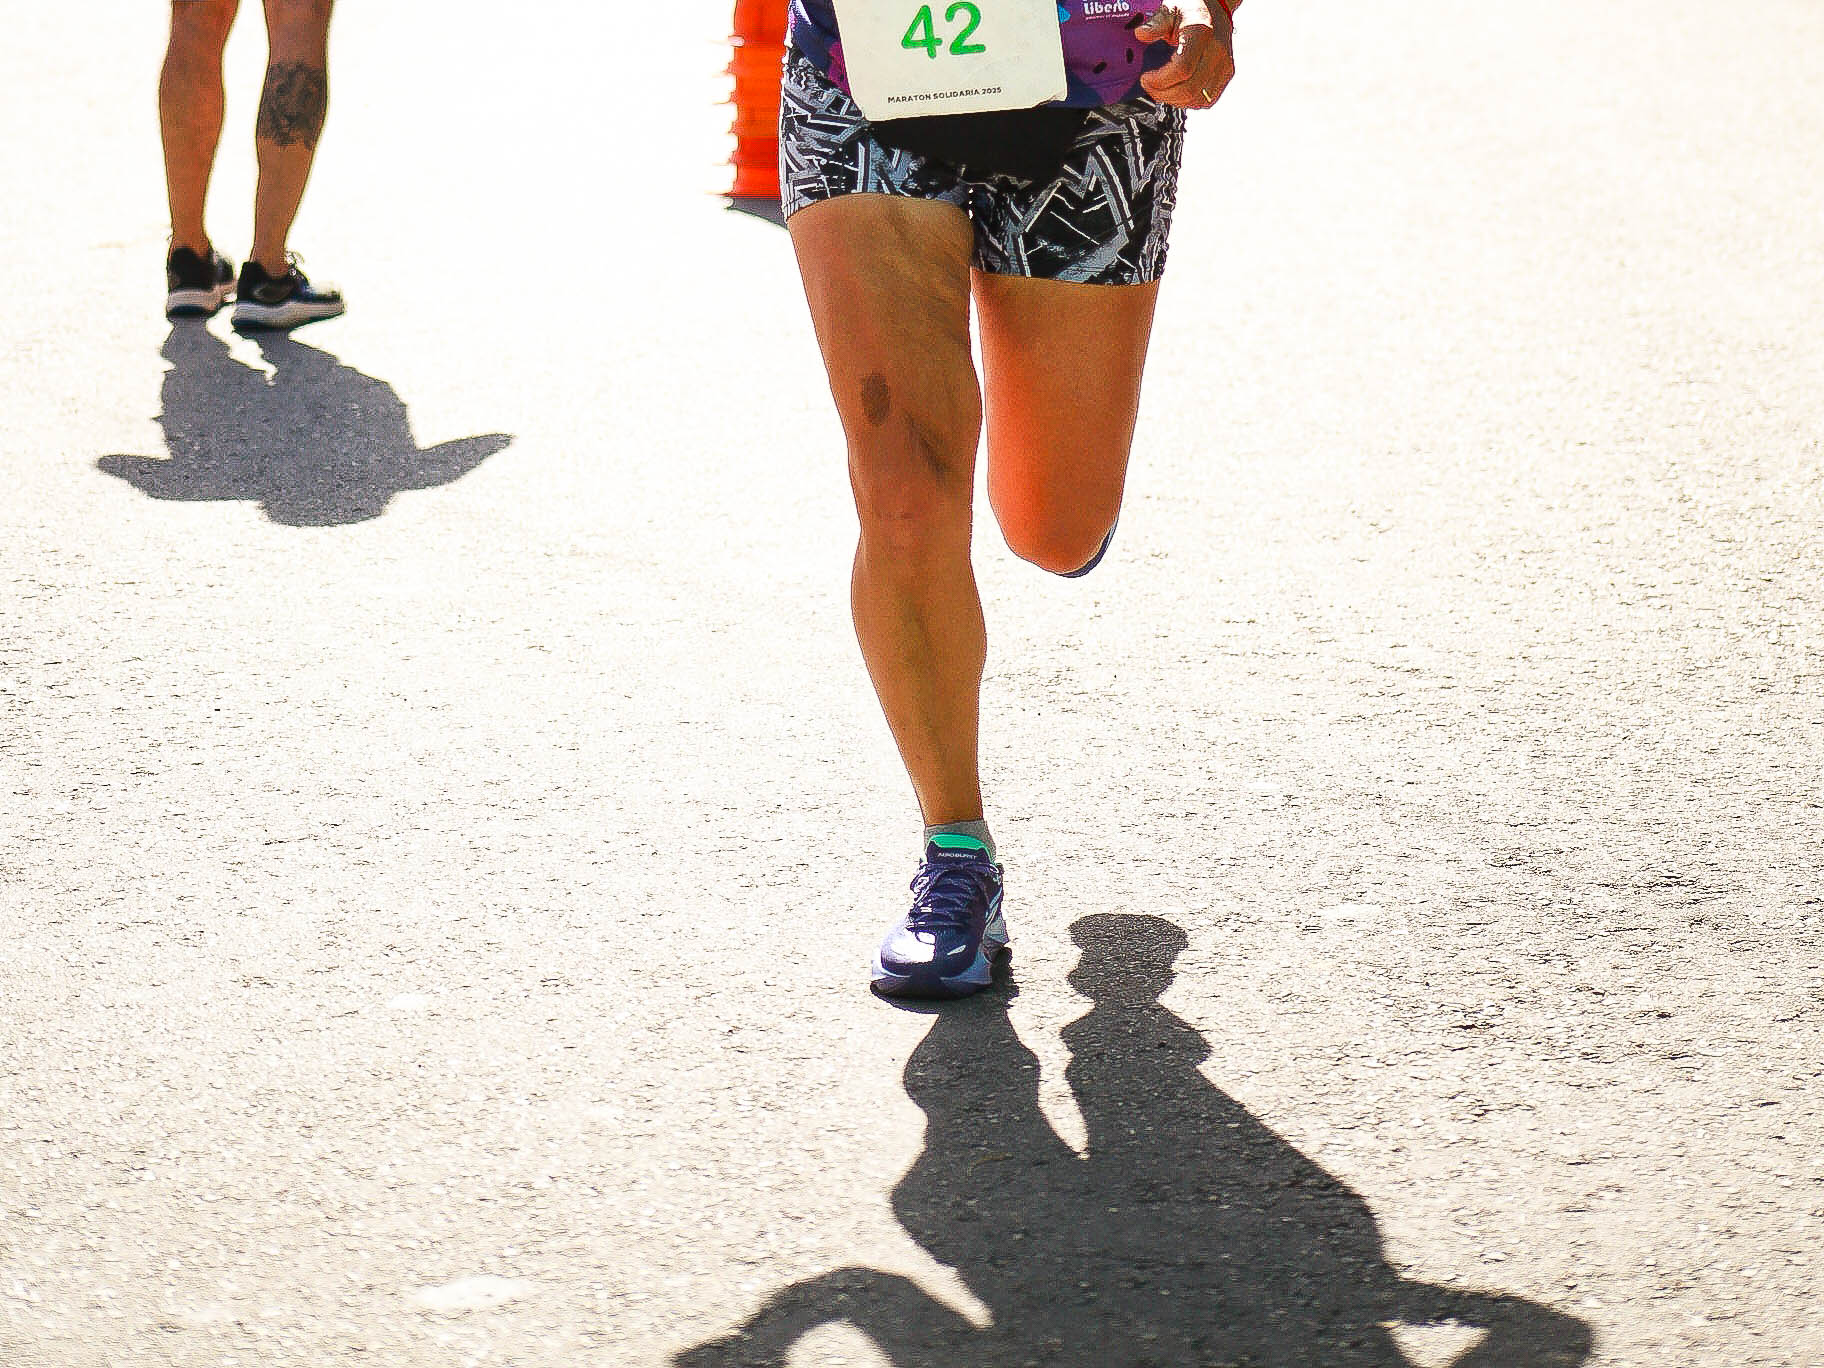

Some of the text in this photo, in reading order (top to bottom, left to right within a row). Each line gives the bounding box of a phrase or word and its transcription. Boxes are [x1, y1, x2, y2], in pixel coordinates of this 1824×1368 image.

[901, 1, 987, 59] 42
[888, 86, 1002, 103] MARATON SOLIDARIA 2025
